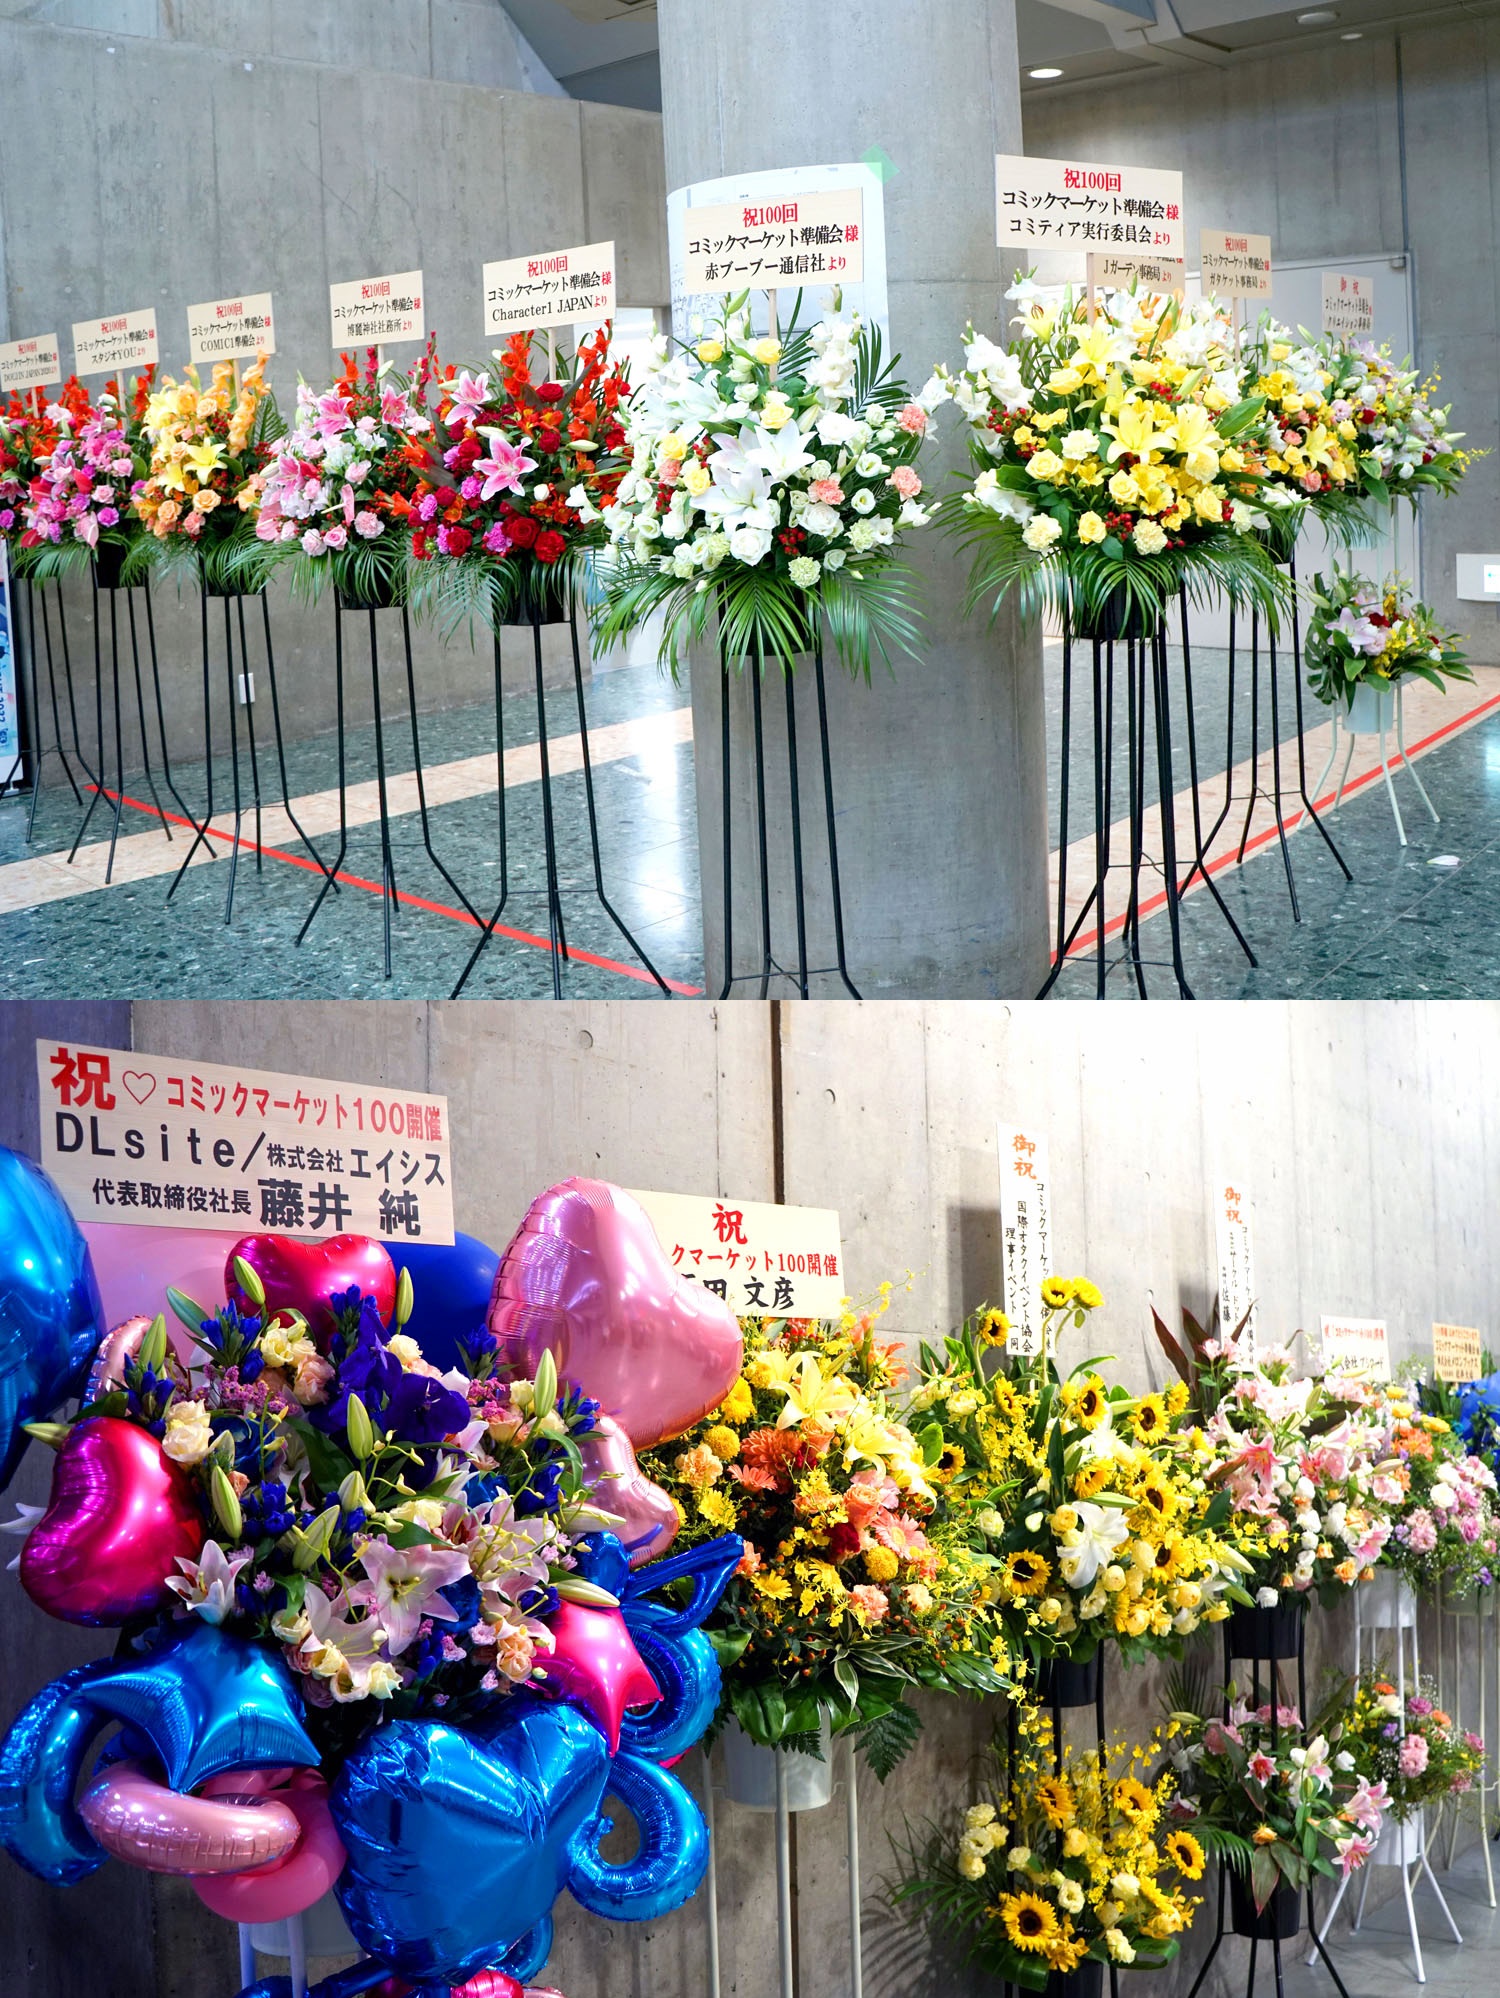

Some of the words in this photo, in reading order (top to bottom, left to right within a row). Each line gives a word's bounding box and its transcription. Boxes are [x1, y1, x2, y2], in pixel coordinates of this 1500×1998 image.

[1064, 168, 1121, 192] 祝100回
[742, 203, 798, 227] 祝100回
[1003, 190, 1179, 220] コミックマーケット準備会様
[689, 224, 859, 254] コミックマーケット準備会様
[1010, 217, 1170, 245] コミティア実行委員会より
[527, 256, 568, 277] 祝100回
[705, 253, 847, 281] 赤ブーブー通信社より
[361, 281, 391, 299] 祝100回
[488, 271, 612, 301] コミックマーケット準備会様
[216, 302, 243, 319] 祝100回
[492, 301, 552, 322] Character1
[101, 318, 127, 334] 祝100回
[50, 1047, 116, 1111] 祝
[167, 1075, 441, 1142] コミックマーケット100開催
[93, 1178, 251, 1216] 代表取締役社長
[258, 1177, 352, 1232] 藤井
[379, 1189, 421, 1237] 純
[712, 1203, 748, 1244] 祝
[744, 1276, 795, 1311] 文彦
